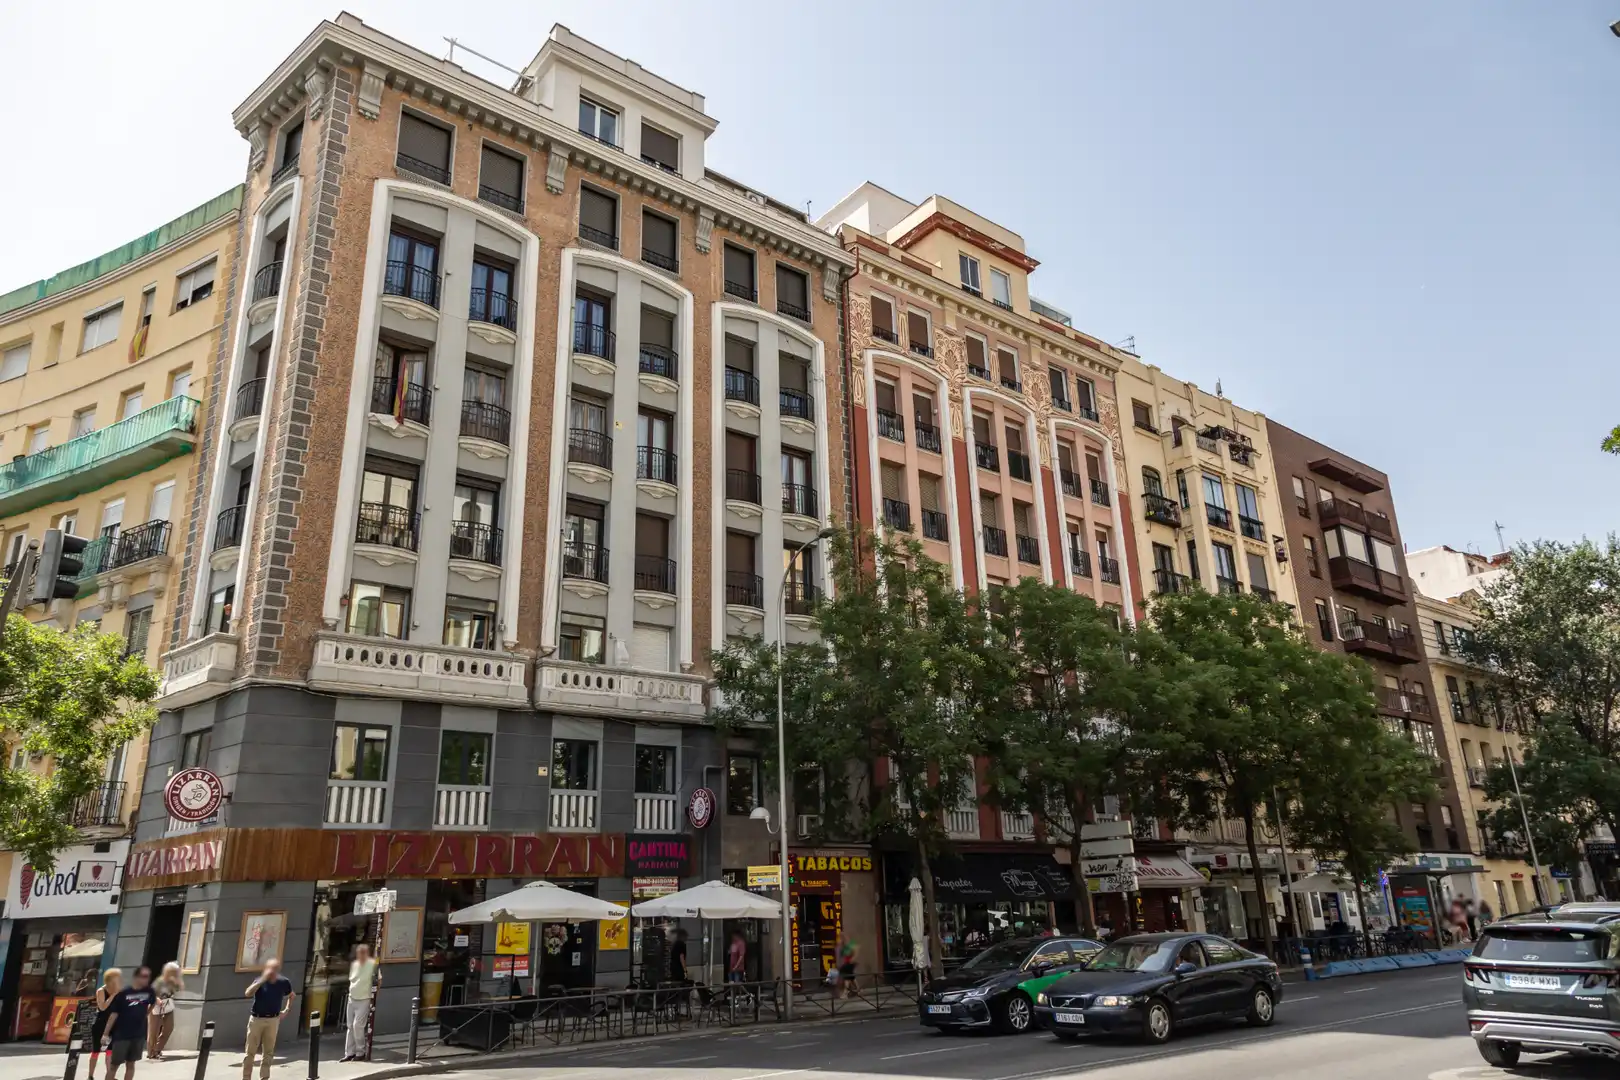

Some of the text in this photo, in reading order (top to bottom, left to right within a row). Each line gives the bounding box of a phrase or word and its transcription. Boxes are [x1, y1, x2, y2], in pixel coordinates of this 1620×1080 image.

[172, 772, 220, 796] LIZARRAN
[172, 796, 187, 814] ORIGEN
[125, 840, 223, 877] LIZARRAN
[332, 834, 624, 875] LIZARRAN
[629, 841, 687, 860] CANTINA
[796, 857, 872, 871] TABACOS
[1133, 866, 1183, 877] ARMACIA
